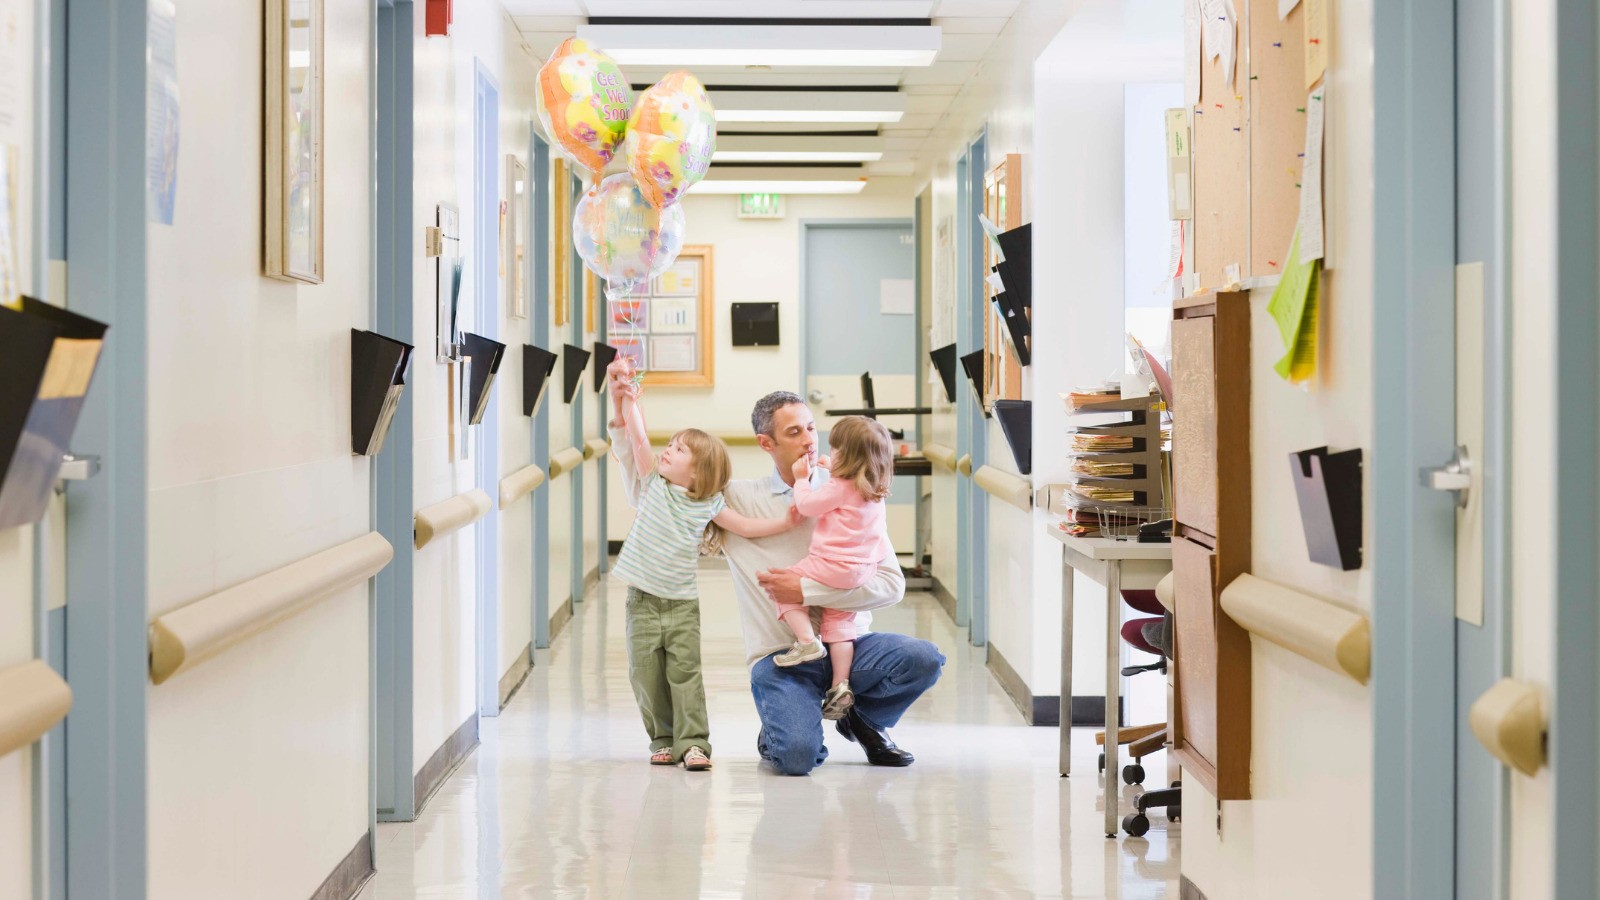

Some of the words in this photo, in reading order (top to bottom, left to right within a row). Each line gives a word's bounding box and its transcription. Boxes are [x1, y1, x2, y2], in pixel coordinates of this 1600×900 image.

[596, 71, 618, 86] Get
[606, 86, 628, 104] Well
[602, 104, 631, 120] Soon
[740, 192, 779, 214] EXIT
